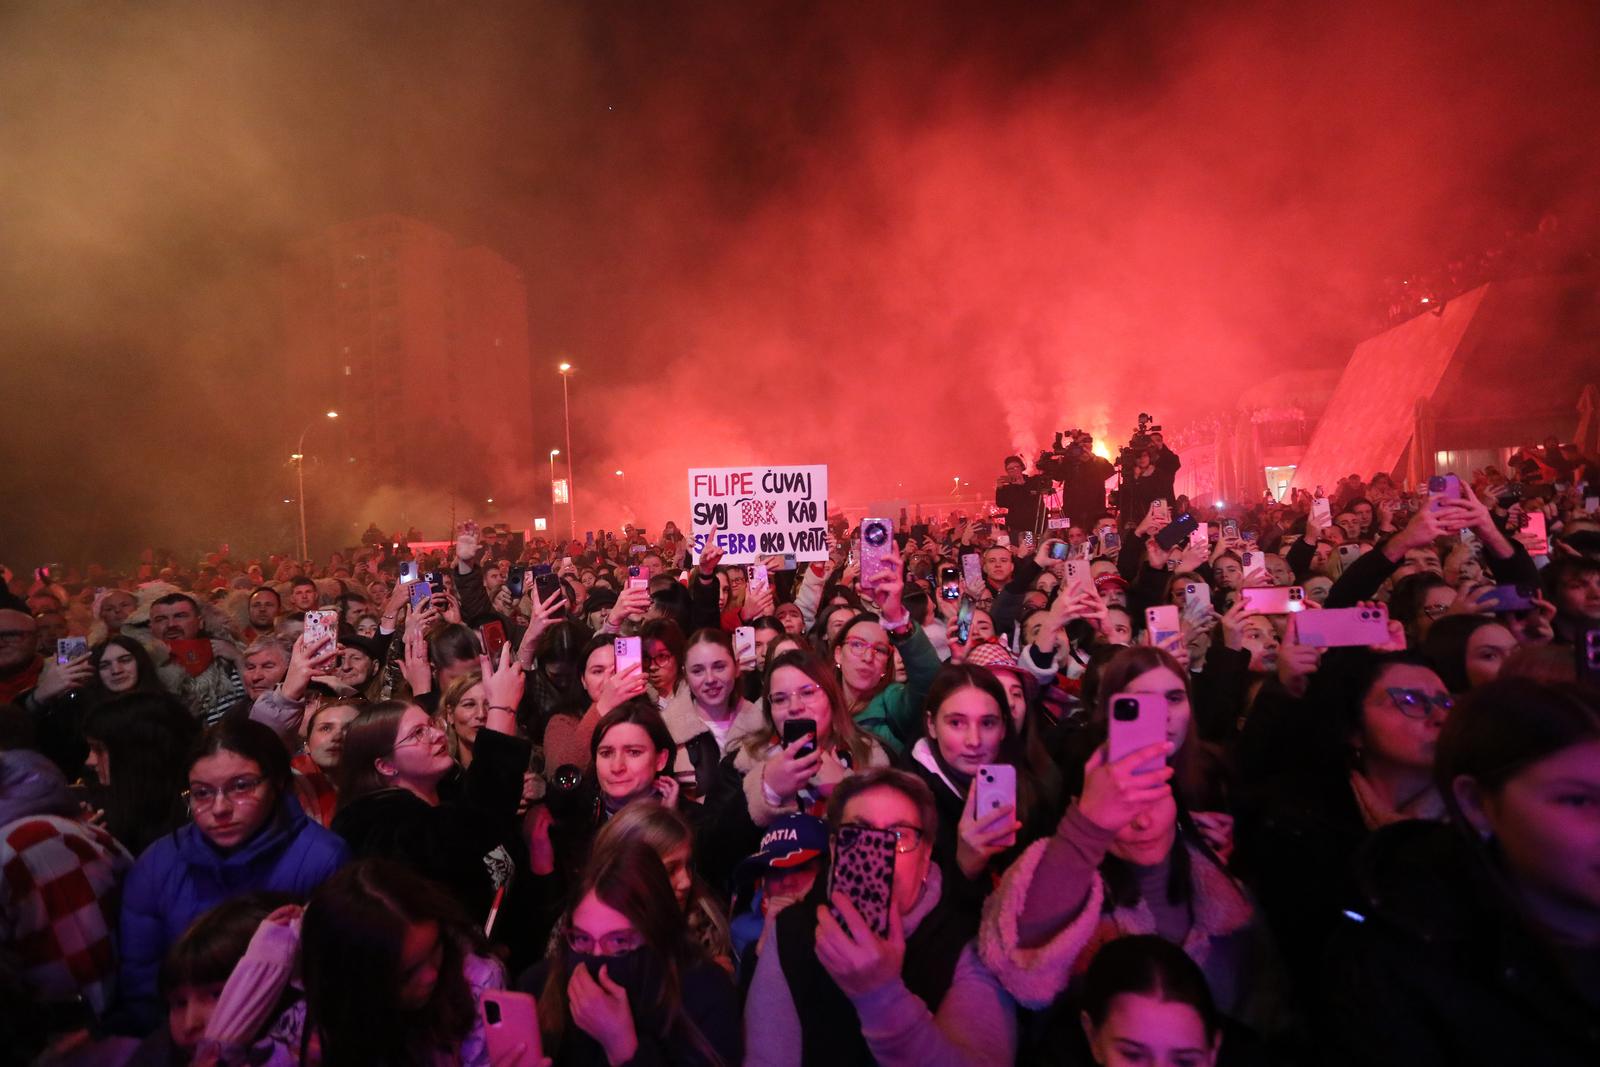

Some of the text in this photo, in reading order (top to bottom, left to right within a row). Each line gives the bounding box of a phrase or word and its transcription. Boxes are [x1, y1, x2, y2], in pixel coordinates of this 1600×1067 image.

[694, 469, 811, 500] FILIPE, ČUVAJ
[693, 502, 728, 530] SVOJ
[741, 500, 778, 527] BRK
[787, 500, 817, 523] KAO
[694, 527, 829, 554] SEBRO OKO VRATA
